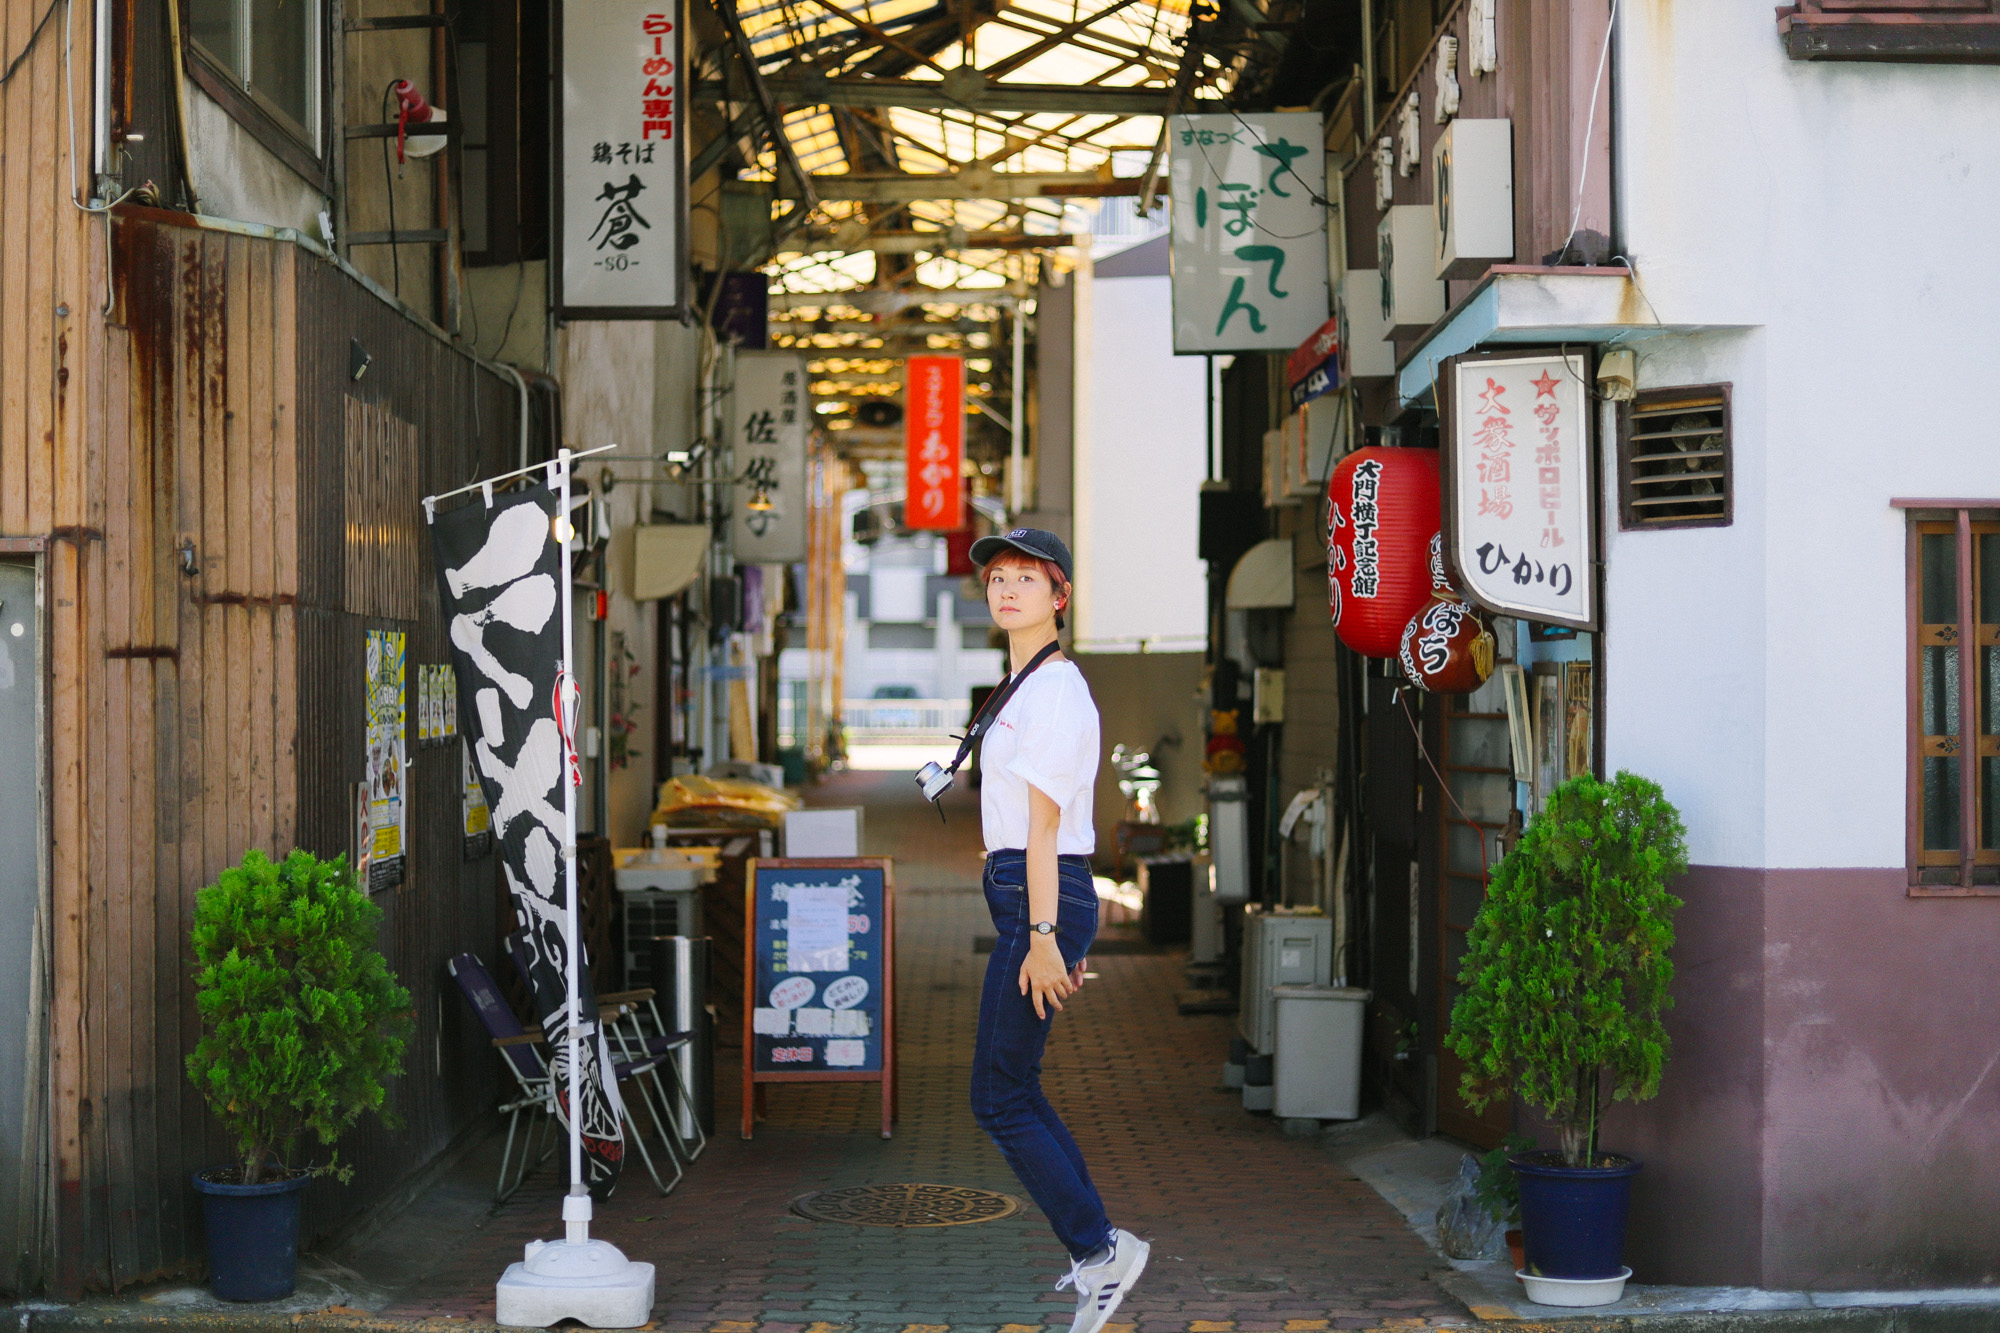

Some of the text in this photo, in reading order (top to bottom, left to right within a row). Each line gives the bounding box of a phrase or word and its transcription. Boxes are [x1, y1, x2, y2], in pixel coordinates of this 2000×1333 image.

[642, 13, 673, 140] らーめん専門
[591, 142, 655, 164] 鶏そば
[1179, 128, 1245, 146] すなっく
[588, 173, 651, 251] 蒼
[1472, 376, 1517, 521] 大衆酒場
[1532, 403, 1566, 549] サッポロビール
[1352, 460, 1382, 598] 大門横丁記念館
[1475, 541, 1573, 596] ひかり
